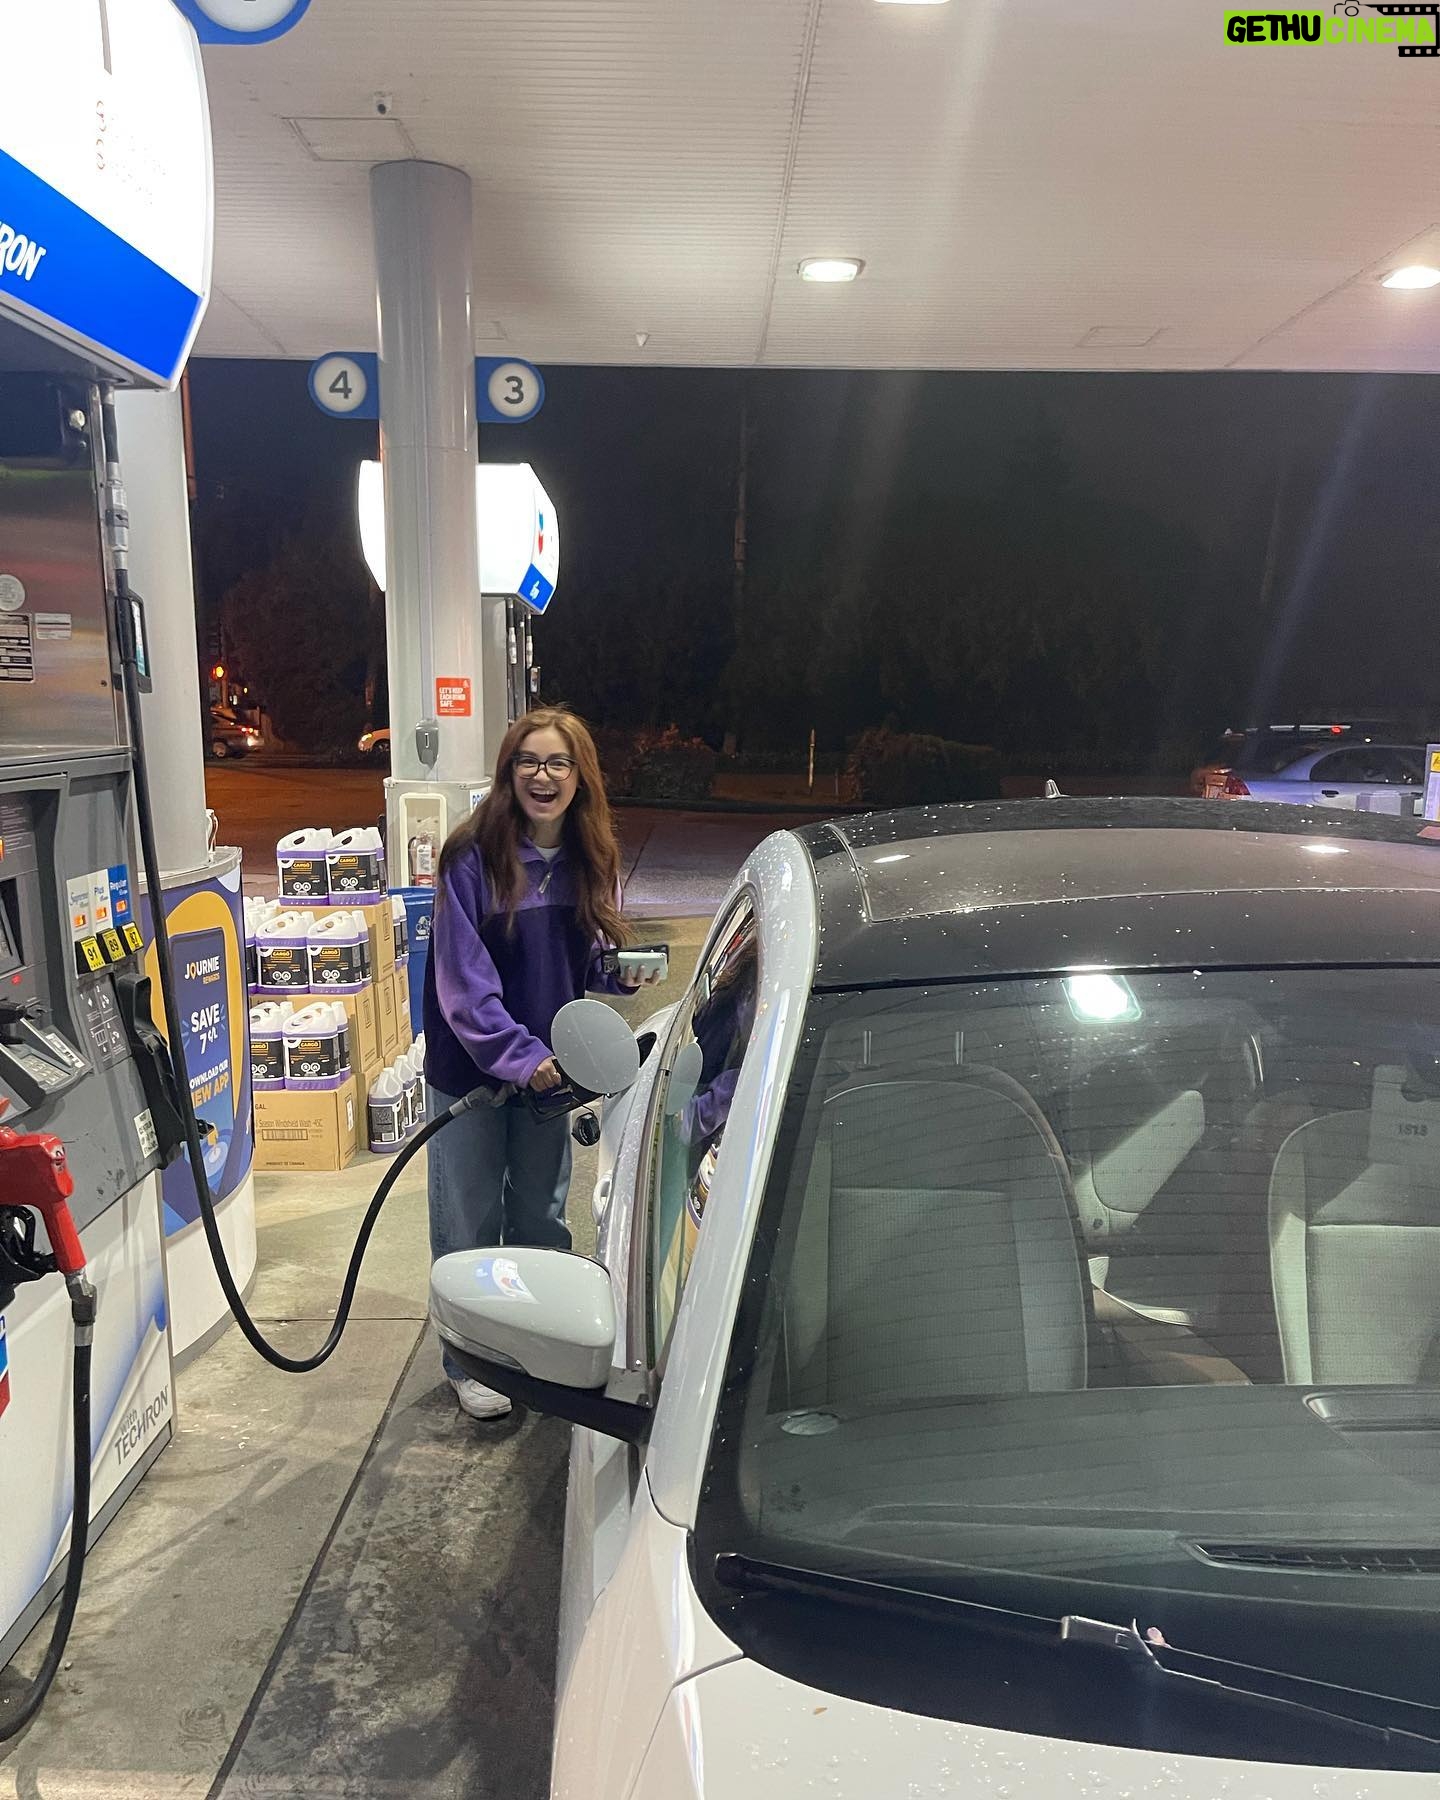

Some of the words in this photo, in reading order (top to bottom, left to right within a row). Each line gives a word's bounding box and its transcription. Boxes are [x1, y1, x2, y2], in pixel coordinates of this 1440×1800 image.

[0, 221, 47, 281] RON
[328, 370, 352, 399] 4
[503, 375, 525, 404] 3
[87, 946, 98, 961] 91
[184, 955, 220, 980] JOURNIE
[190, 1003, 220, 1033] SAVE
[189, 1065, 219, 1090] OWNLOAD
[213, 1071, 229, 1097] APP
[114, 1383, 169, 1466] TECHRON
